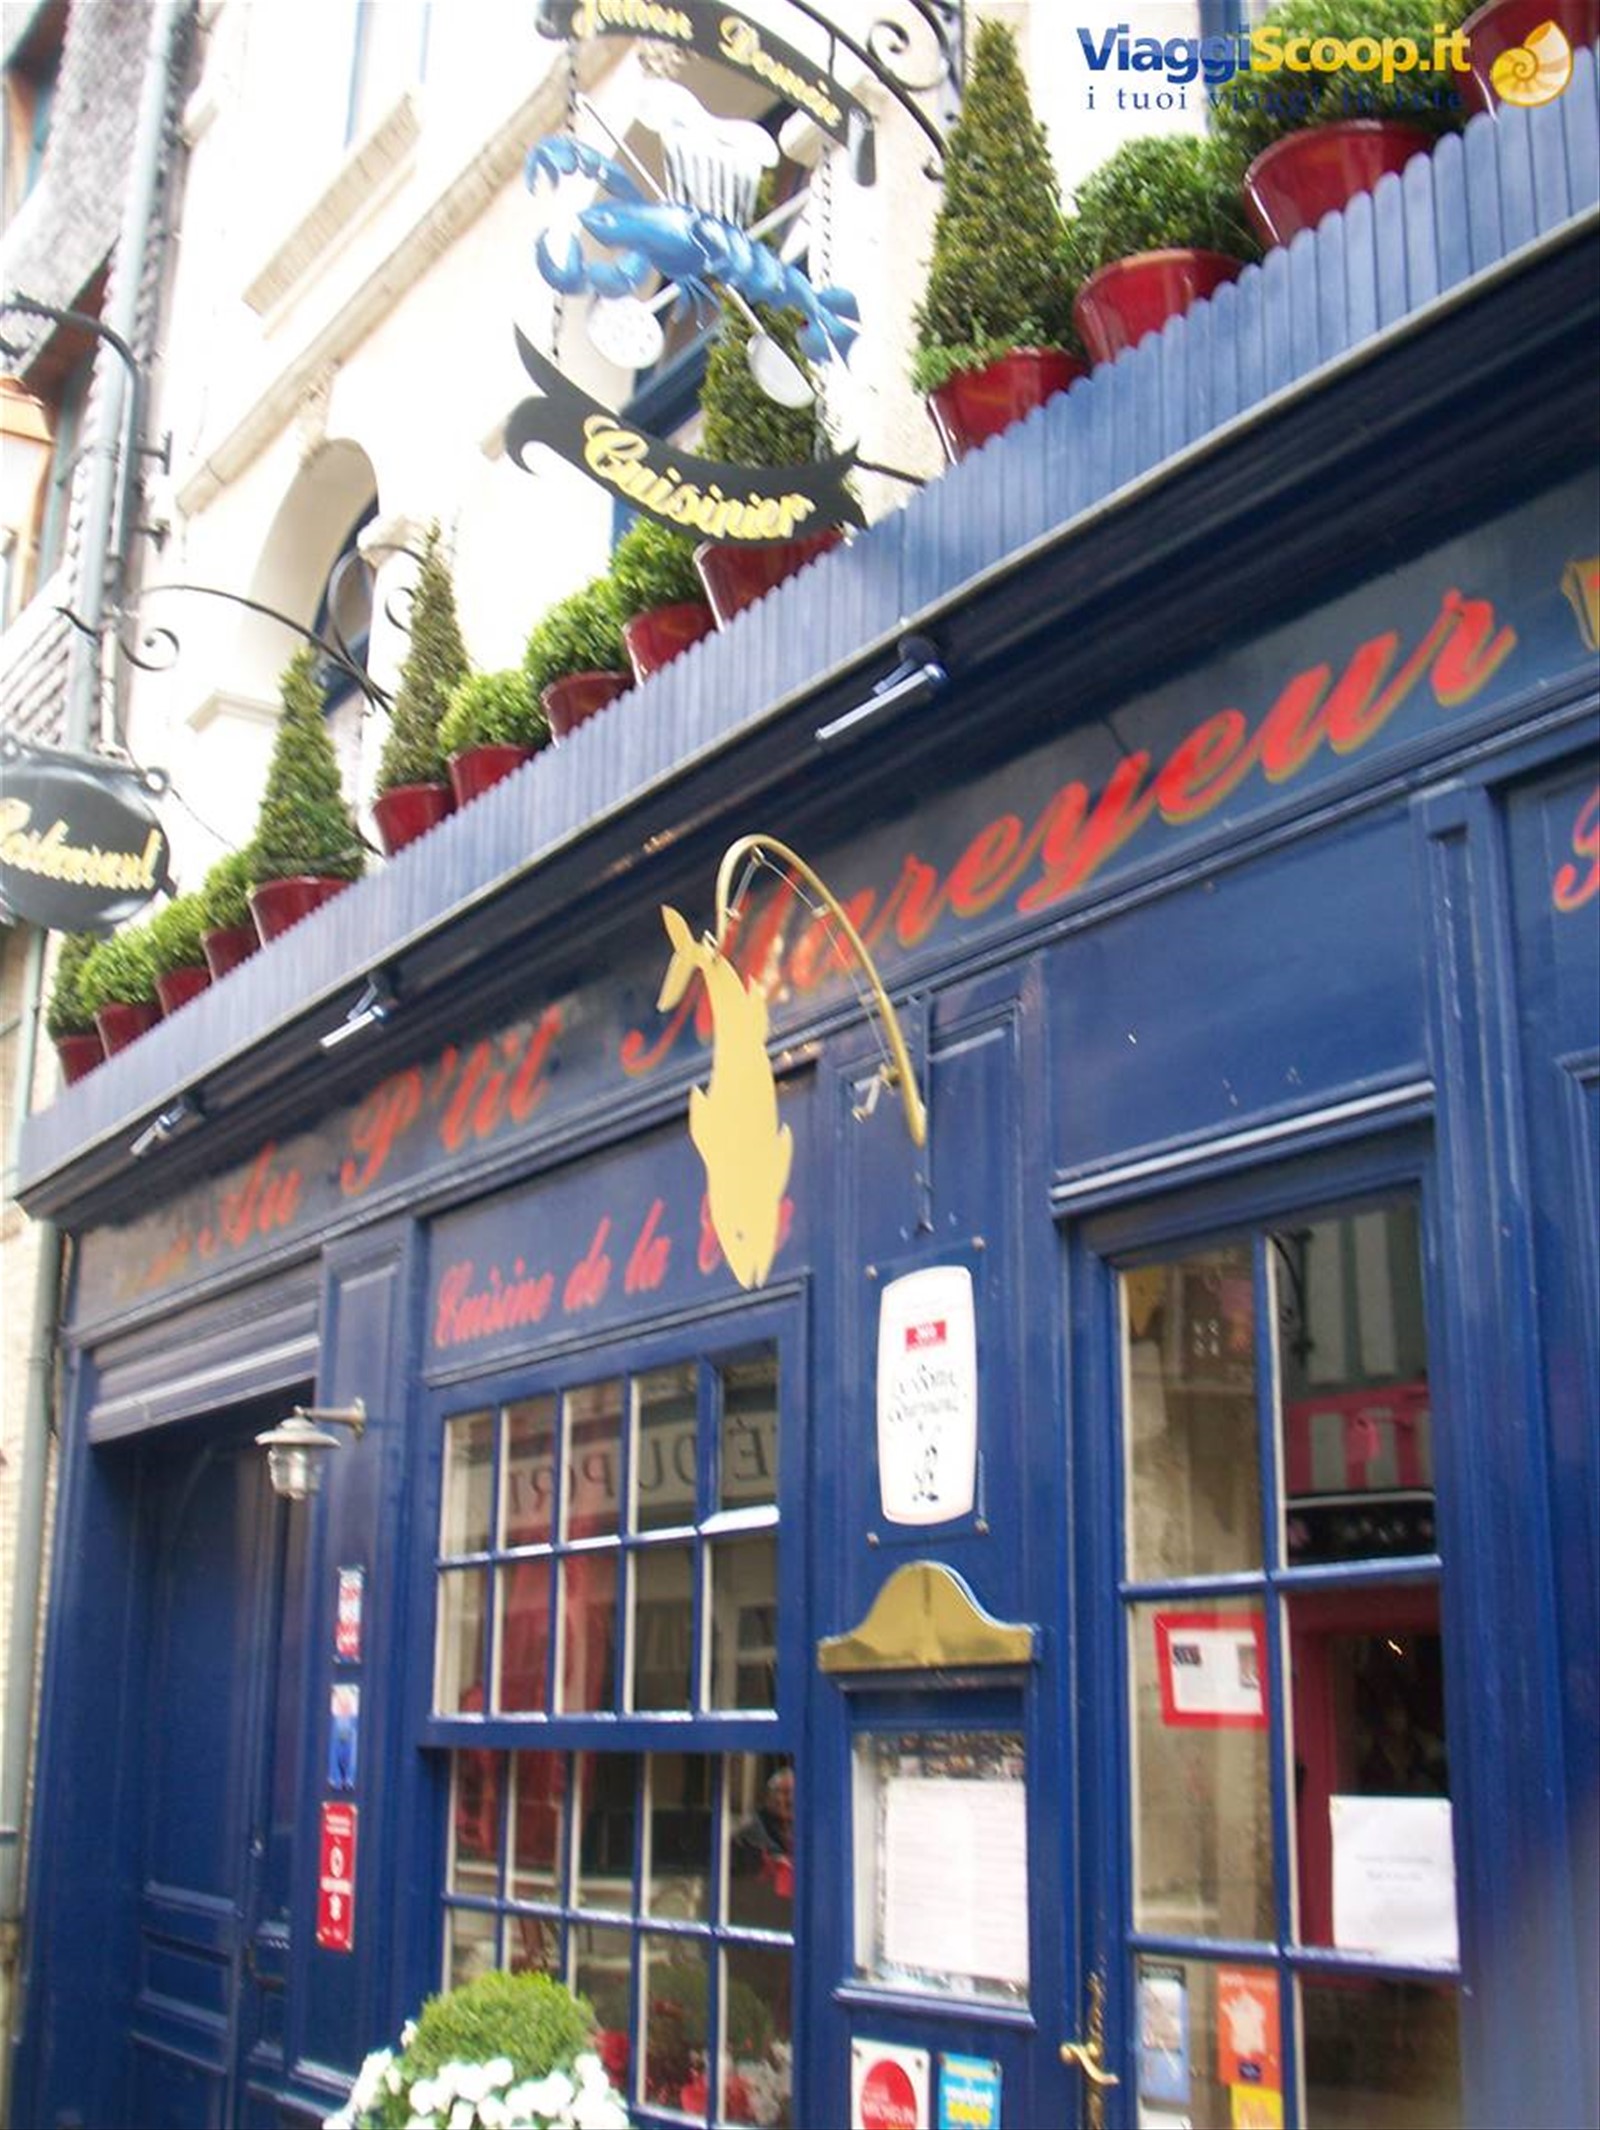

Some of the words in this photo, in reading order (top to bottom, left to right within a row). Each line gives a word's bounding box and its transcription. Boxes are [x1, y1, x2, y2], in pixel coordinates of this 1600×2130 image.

[583, 414, 816, 540] Cuisinier
[620, 588, 1517, 1077] Mareyeur
[562, 1215, 612, 1314] de
[624, 1198, 672, 1295] la
